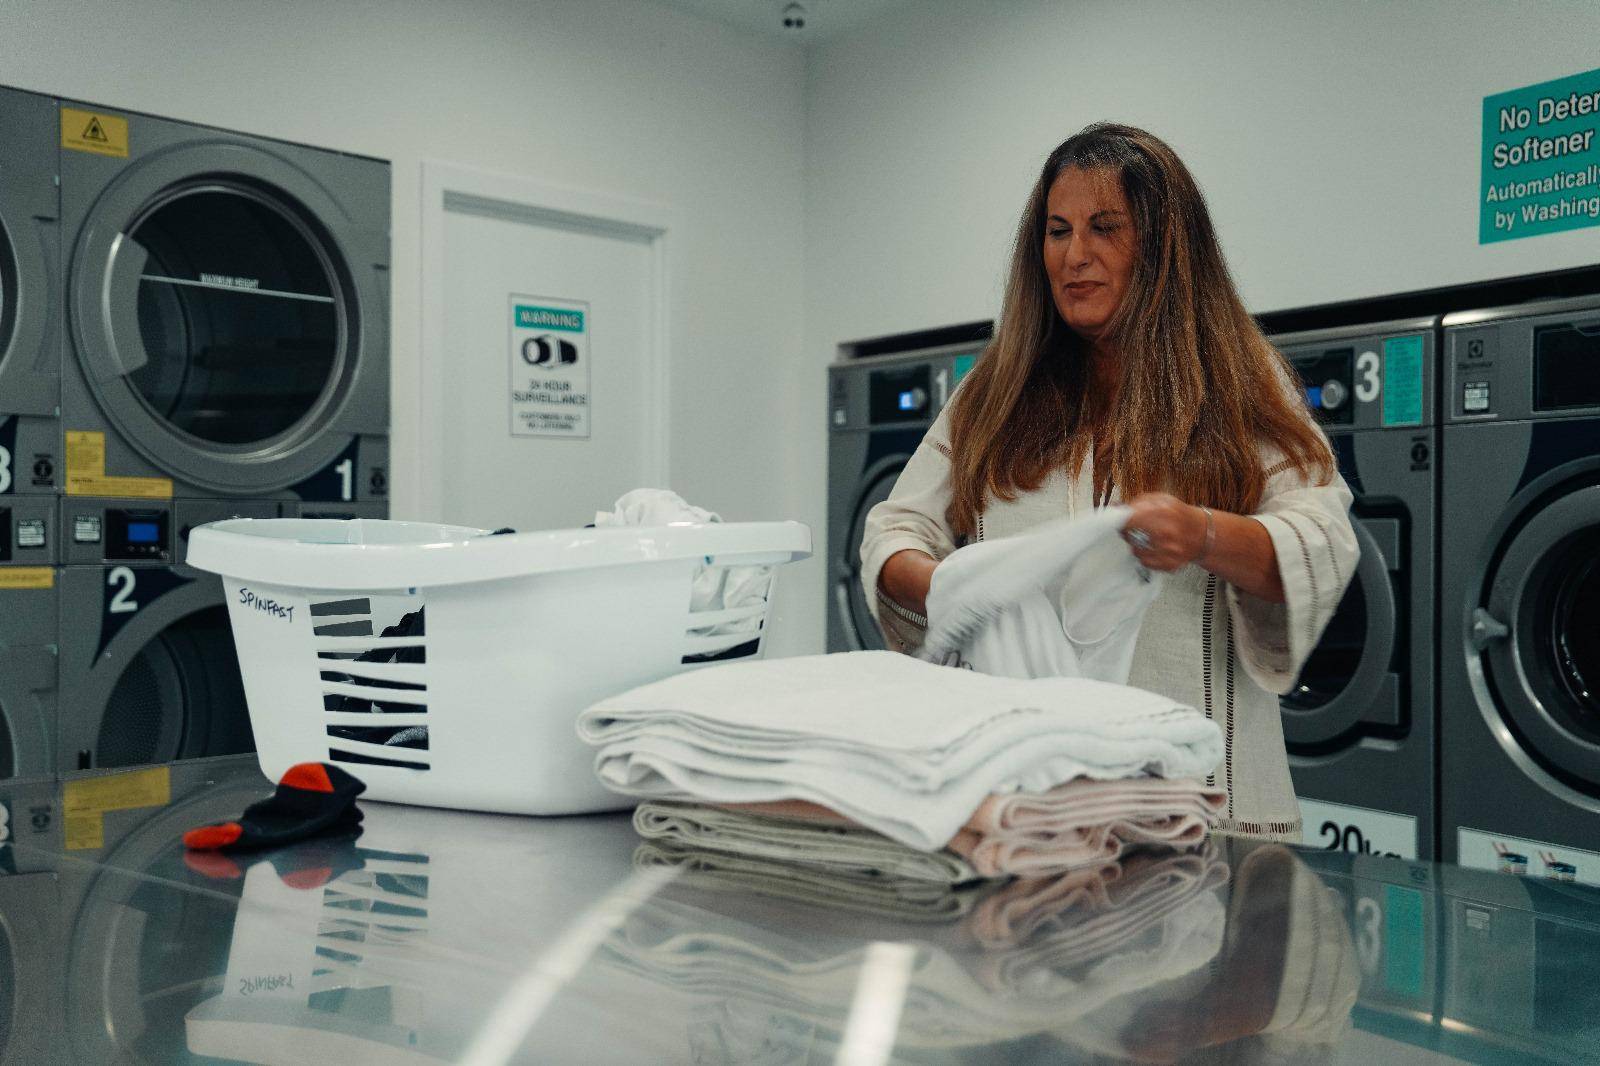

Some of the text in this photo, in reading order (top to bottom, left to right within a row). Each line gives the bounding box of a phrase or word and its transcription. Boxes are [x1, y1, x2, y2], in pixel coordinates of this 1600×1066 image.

[1499, 91, 1600, 132] No Deter
[1493, 128, 1594, 169] Softener
[1495, 196, 1600, 232] by Washing
[520, 310, 580, 329] WARNING
[935, 368, 948, 407] 1
[1355, 350, 1381, 403] 3
[513, 393, 587, 406] SURVEILLANCE
[335, 458, 353, 502] 1
[107, 566, 138, 614] 2
[240, 588, 294, 623] SPINFAST
